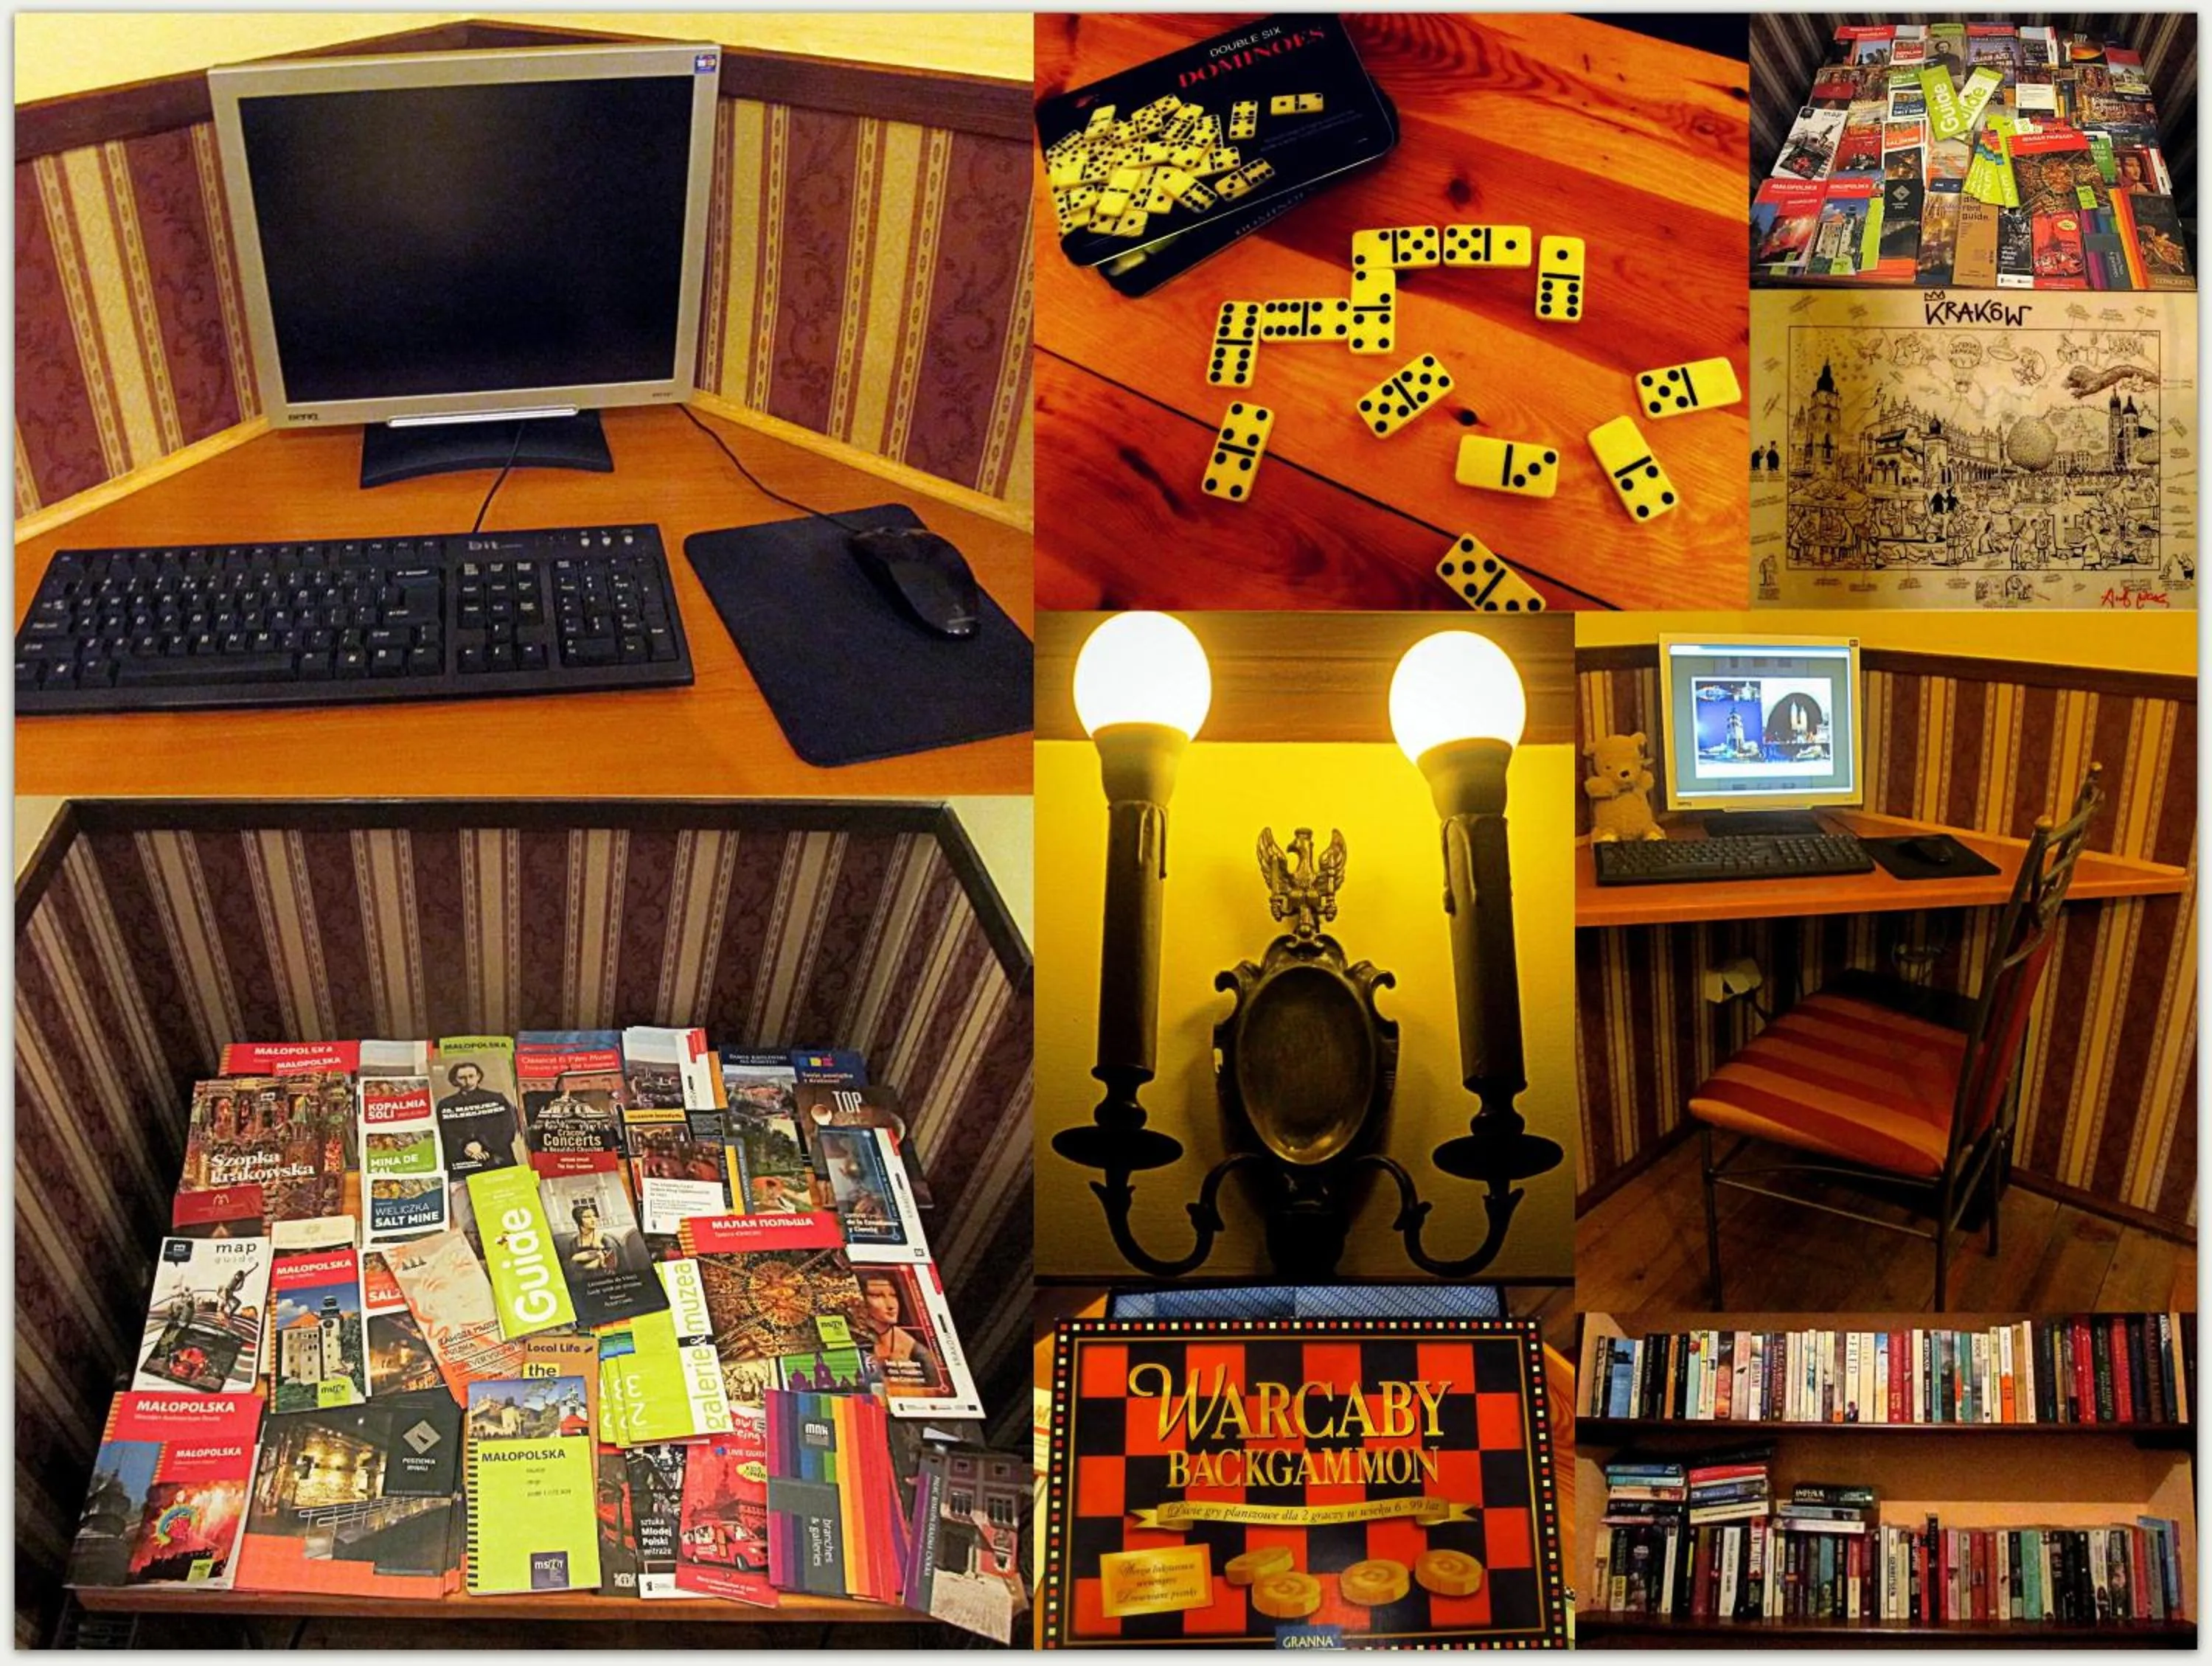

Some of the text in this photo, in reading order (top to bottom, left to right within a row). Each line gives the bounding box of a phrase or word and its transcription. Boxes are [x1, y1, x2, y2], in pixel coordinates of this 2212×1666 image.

[1209, 26, 1281, 57] DOUBLE SIX
[1179, 24, 1324, 88] DOMINOES
[1934, 82, 1960, 133] Guide
[254, 1045, 333, 1056] MAŁOPOLSKA
[368, 1098, 426, 1112] KOPALNIA
[832, 1090, 863, 1113] TOP
[368, 1109, 394, 1120] SOLI
[543, 1133, 602, 1146] Concerts
[211, 1151, 280, 1168] Szopka
[371, 1154, 419, 1167] MINA DE
[375, 1202, 430, 1216] WIELICZKA
[375, 1211, 439, 1227] SALT MINE
[711, 1218, 814, 1230] МАЛАЯ ПОЛЬША
[215, 1242, 257, 1255] map
[276, 1259, 352, 1275] MAŁOPOLSKA
[500, 1207, 559, 1325] Guide
[682, 1263, 707, 1335] muzea
[527, 1344, 580, 1353] Local Life
[528, 1364, 557, 1377] the
[692, 1348, 729, 1429] galerie
[136, 1400, 236, 1413] MAŁOPOLSKA
[1128, 1362, 1453, 1442] WARCABY
[175, 1446, 242, 1459] MAŁOPOLSKA
[481, 1449, 566, 1463] MAŁOPOLSKA
[1167, 1446, 1439, 1488] BACKGAMMON
[1204, 1508, 1220, 1520] gry
[1282, 1508, 1298, 1521] dla
[1301, 1509, 1309, 1521] 2
[1311, 1510, 1344, 1522] graczy
[1282, 1634, 1334, 1650] GRANNA
